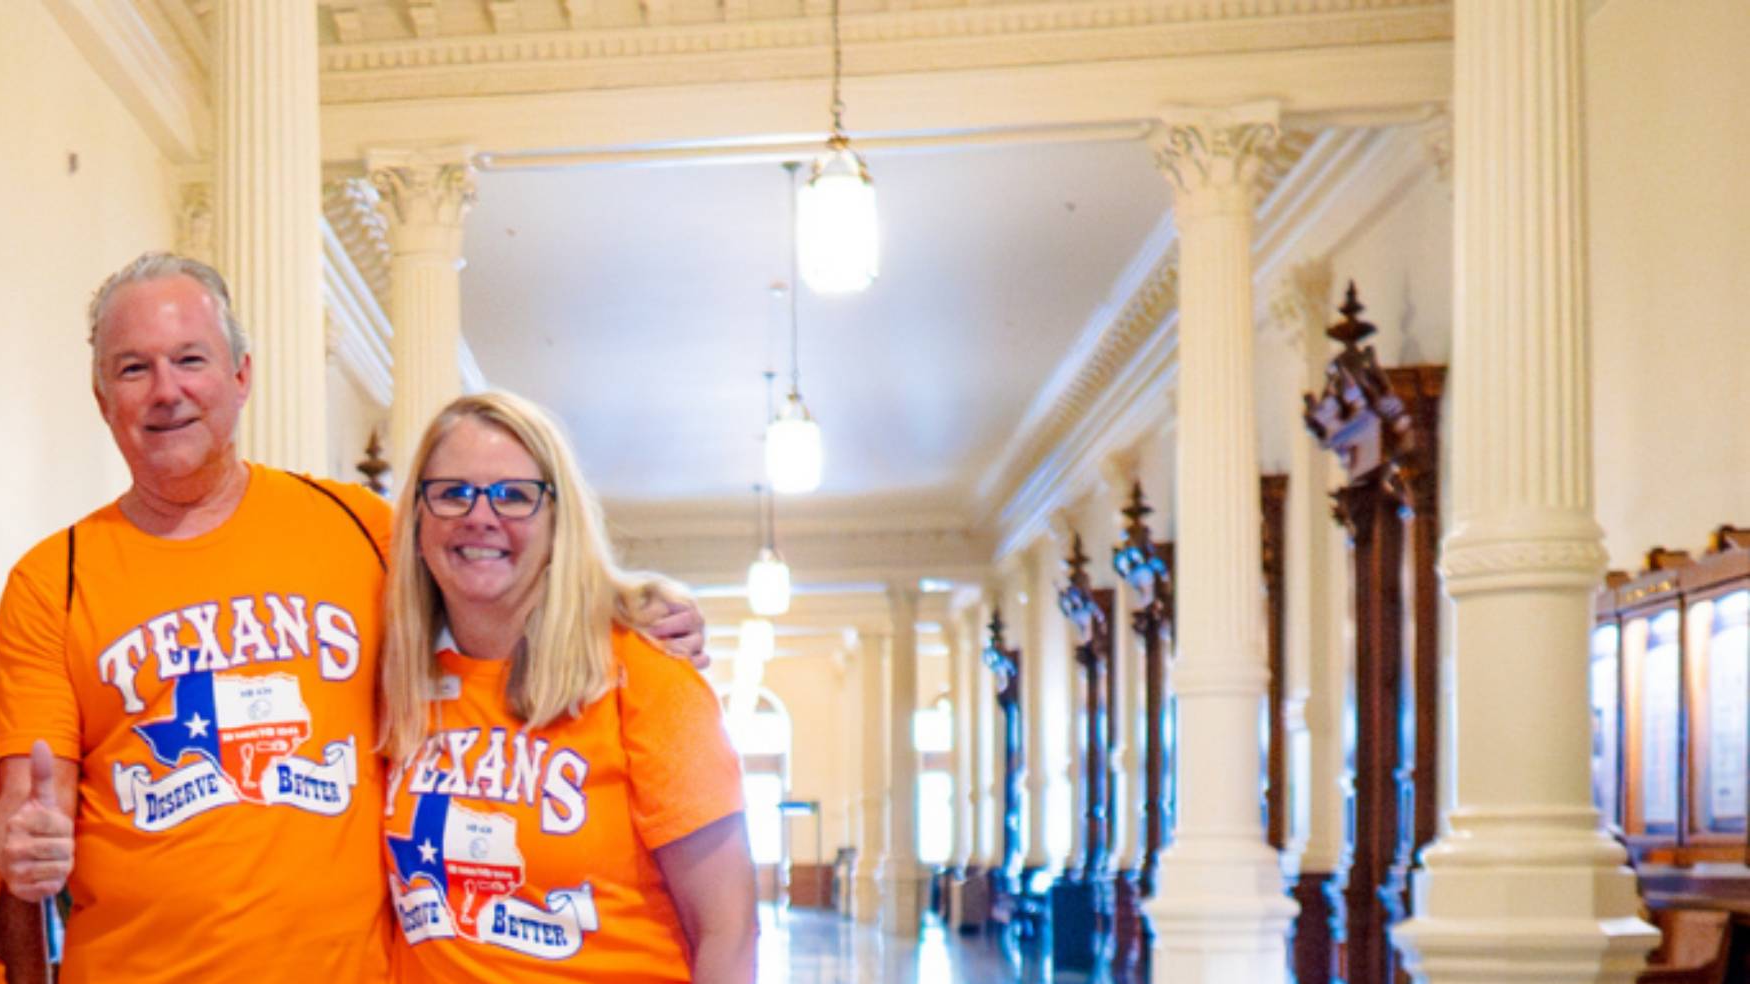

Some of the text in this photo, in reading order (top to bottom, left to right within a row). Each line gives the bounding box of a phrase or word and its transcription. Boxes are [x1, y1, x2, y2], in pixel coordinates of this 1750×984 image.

[98, 592, 360, 714] TEXANS
[145, 764, 342, 824] DESERVE BETTER
[492, 903, 568, 947] BETTER
